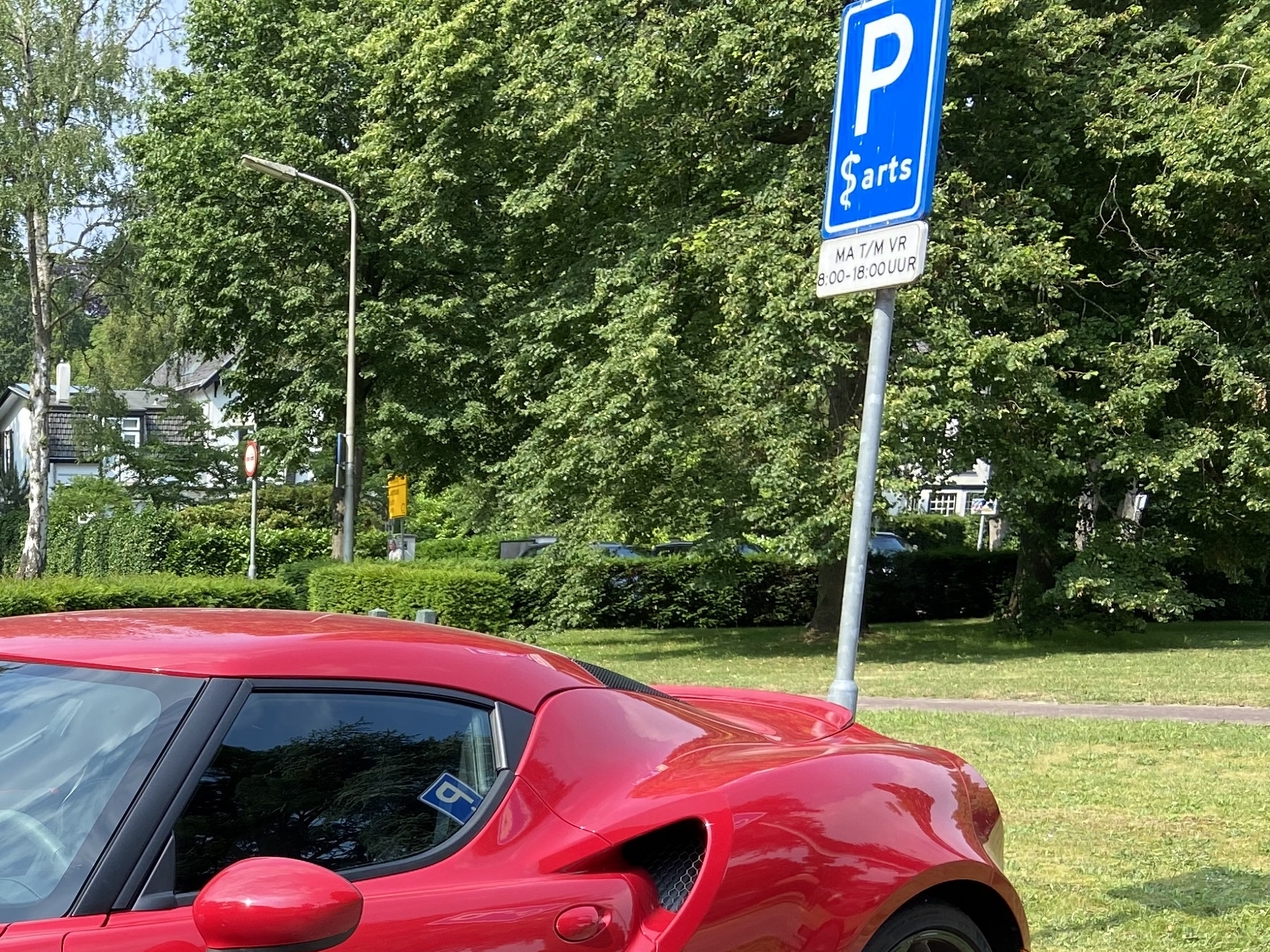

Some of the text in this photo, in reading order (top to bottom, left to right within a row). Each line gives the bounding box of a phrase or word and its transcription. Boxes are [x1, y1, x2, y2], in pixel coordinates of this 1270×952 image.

[854, 12, 914, 137] P
[861, 155, 913, 190] arts
[835, 235, 907, 263] MA T/M VR
[887, 256, 917, 274] UUR
